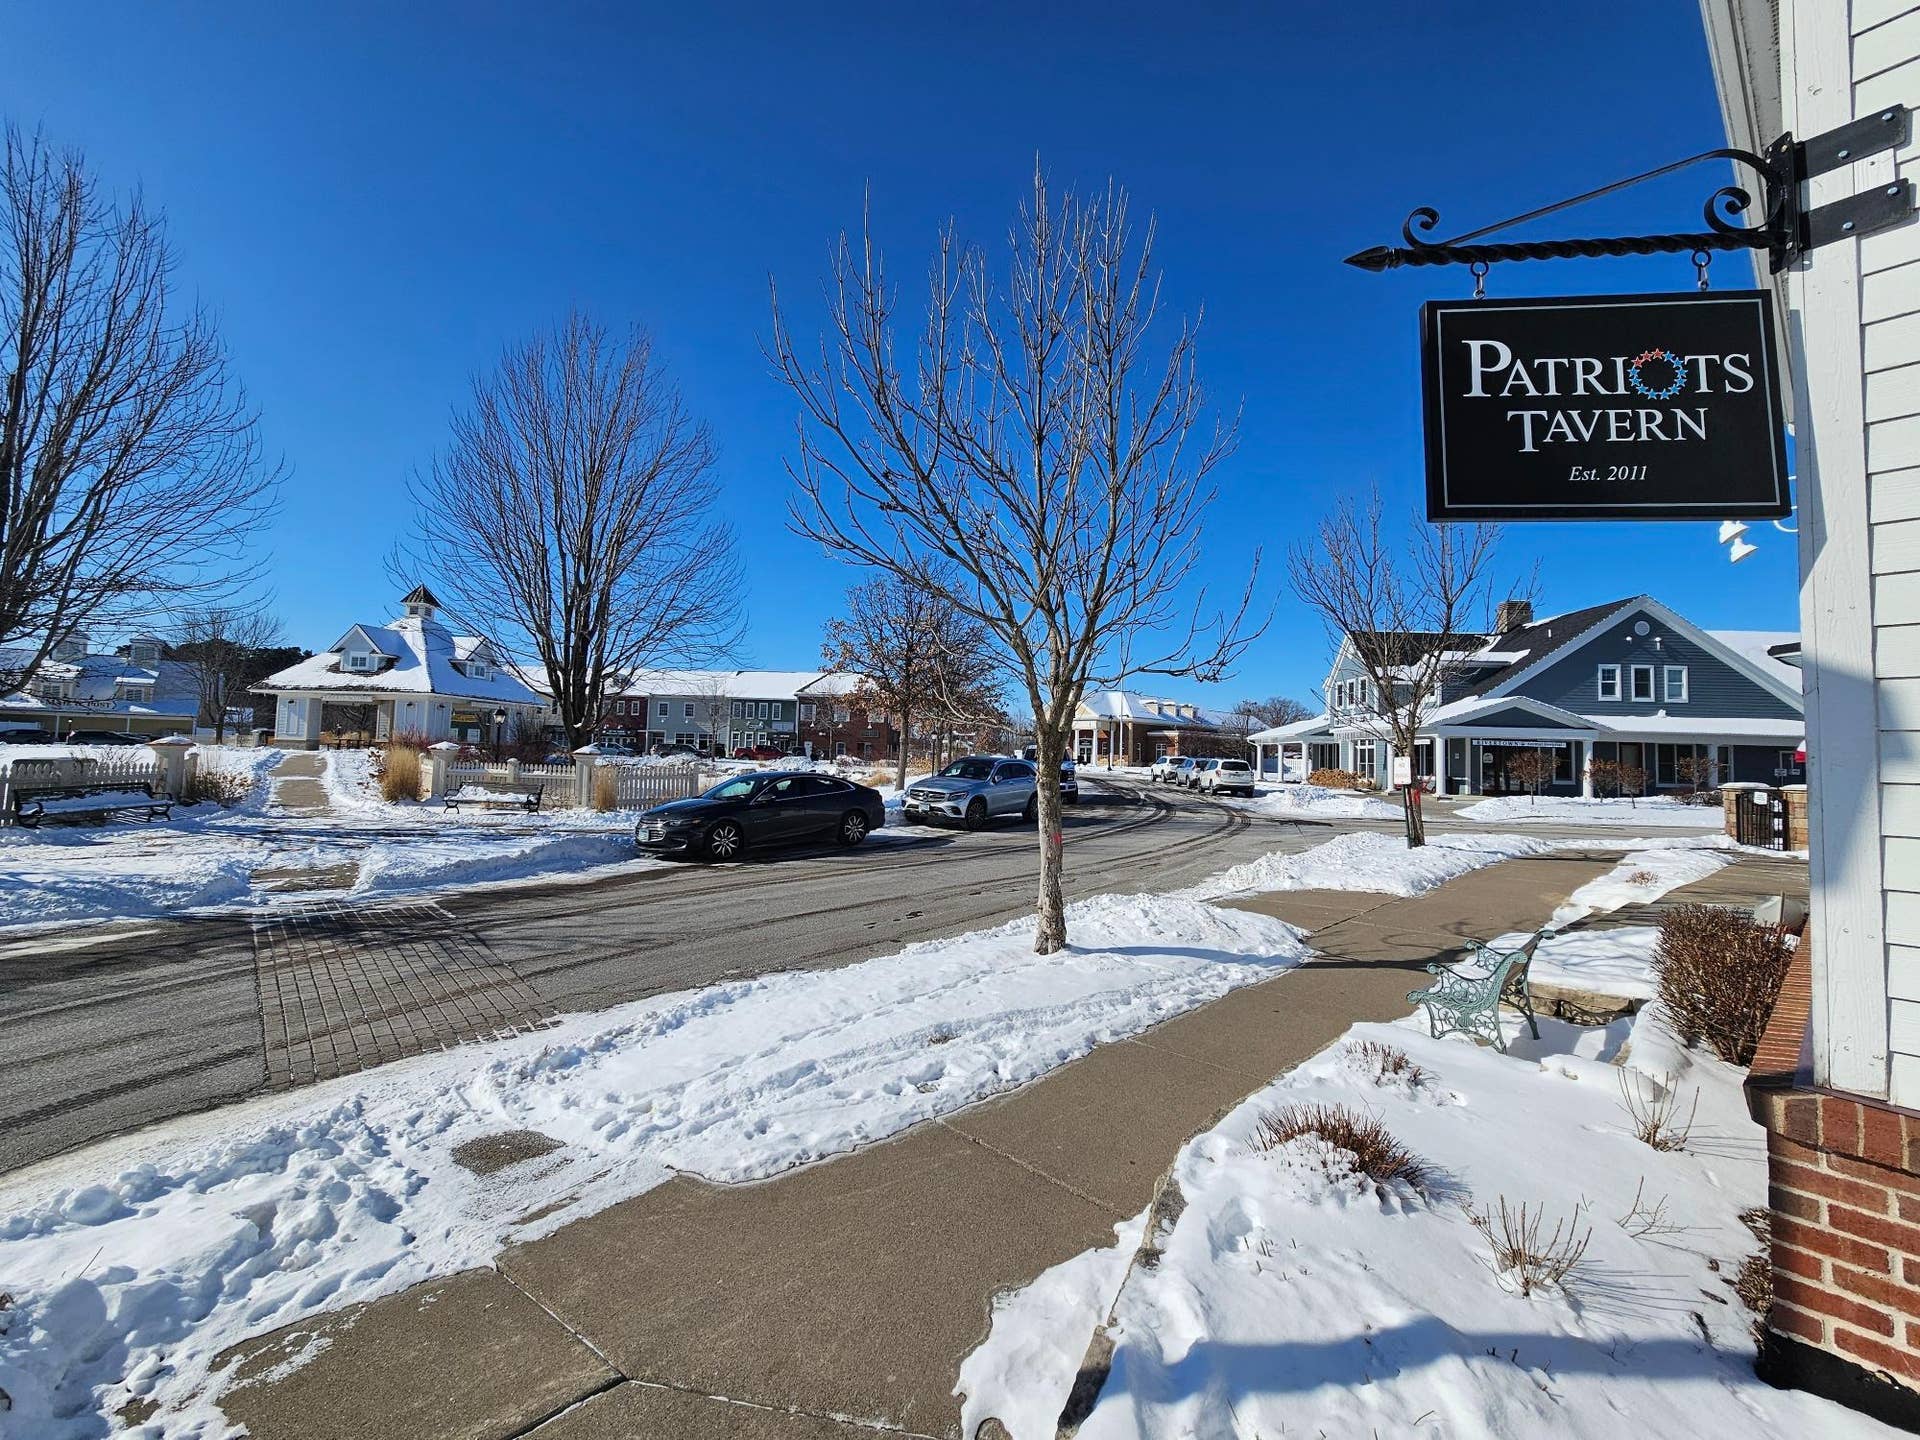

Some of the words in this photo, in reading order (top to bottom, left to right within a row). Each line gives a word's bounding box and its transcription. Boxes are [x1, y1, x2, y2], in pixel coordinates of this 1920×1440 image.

[1462, 339, 1754, 400] PATRIOTS
[1507, 408, 1708, 453] TAVERN
[1569, 466, 1600, 480] Est.
[1608, 466, 1648, 480] 2011
